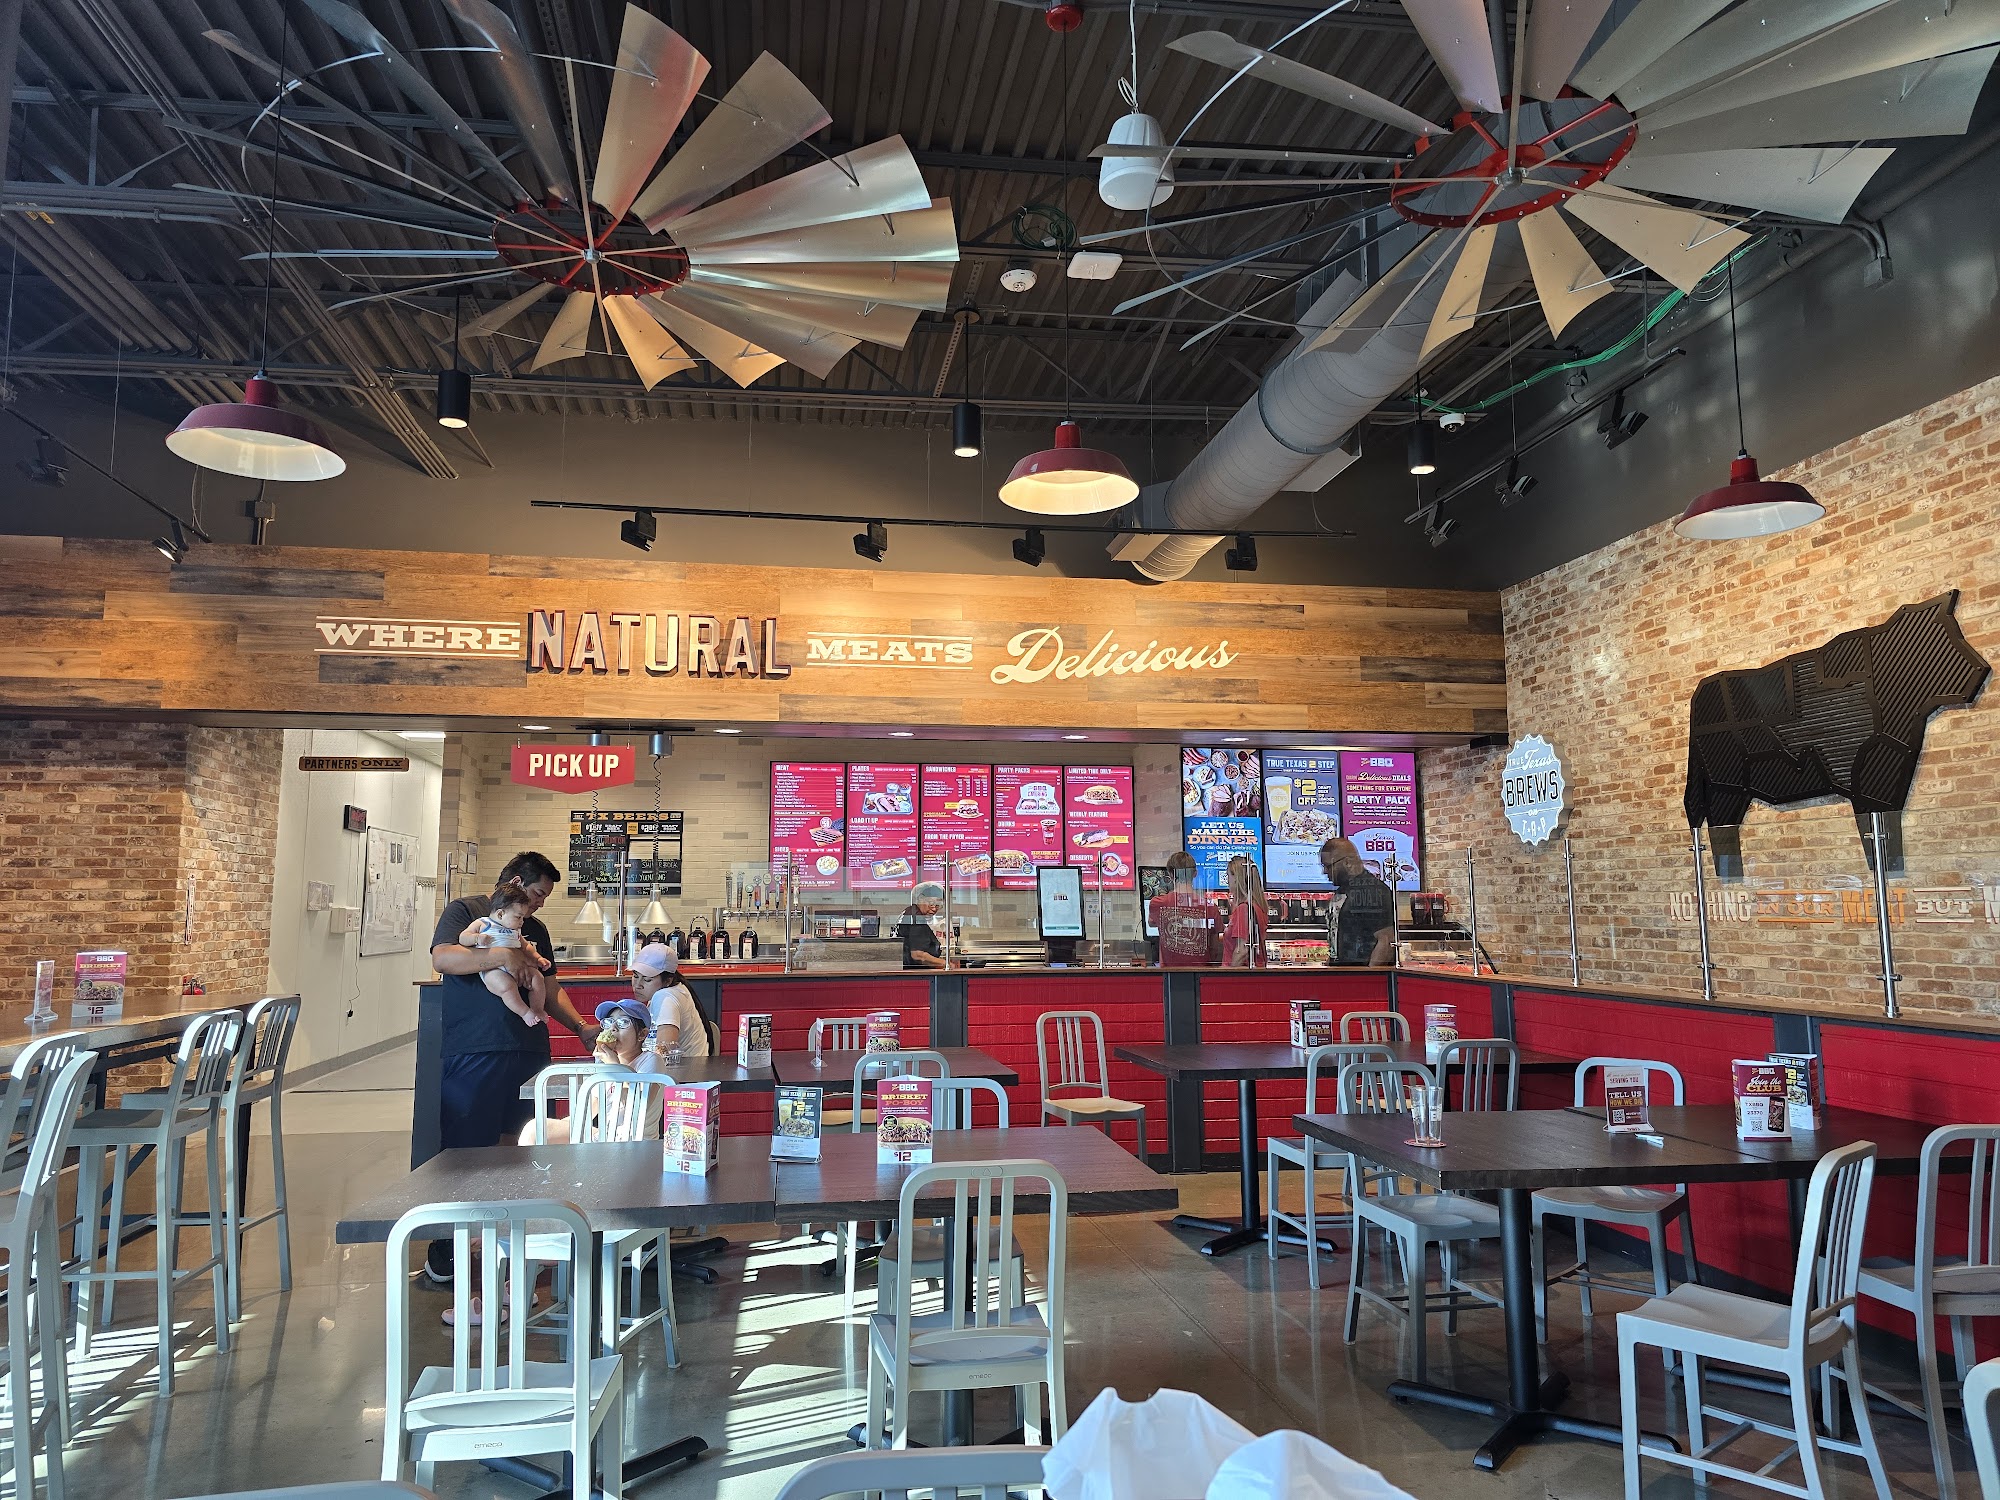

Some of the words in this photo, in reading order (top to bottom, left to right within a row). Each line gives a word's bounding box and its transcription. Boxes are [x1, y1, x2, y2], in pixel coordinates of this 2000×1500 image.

[316, 622, 520, 650] WHERE
[528, 608, 791, 679] NATURAL
[807, 638, 974, 664] MEATS
[990, 626, 1239, 684] Delicious
[1370, 757, 1395, 767] BBQ
[1509, 756, 1524, 766] TRUE
[1522, 748, 1553, 769] Texas
[304, 759, 358, 769] PARTNERS
[361, 759, 402, 767] ONLY
[529, 753, 584, 777] PICK
[589, 754, 619, 777] UP
[1266, 759, 1284, 767] TRUE
[1286, 760, 1307, 768] TEXAS
[1308, 760, 1317, 768] 2
[1318, 761, 1335, 769] STEP
[1392, 774, 1412, 782] DEALS
[1294, 778, 1317, 796] $2
[1505, 770, 1560, 806] BREWS
[1297, 797, 1317, 805] OFF
[1347, 795, 1382, 804] PARTY
[1385, 795, 1412, 805] PACK
[613, 812, 669, 820] BEERS
[1200, 821, 1225, 829] LET
[1187, 834, 1259, 845] DINNER
[1365, 841, 1397, 851] BBQ
[1669, 891, 1751, 921] NOHING
[1757, 901, 1780, 914] IN
[1787, 902, 1834, 915] OUR
[1915, 899, 1973, 914] BUT
[88, 1006, 104, 1014] $12
[1750, 1075, 1769, 1086] Join
[1769, 1076, 1782, 1085] the
[898, 1083, 918, 1092] BBQ
[1746, 1084, 1782, 1092] CLUB
[669, 1107, 700, 1115] PO-BOY
[893, 1151, 912, 1162] $12
[676, 1160, 690, 1172] $12
